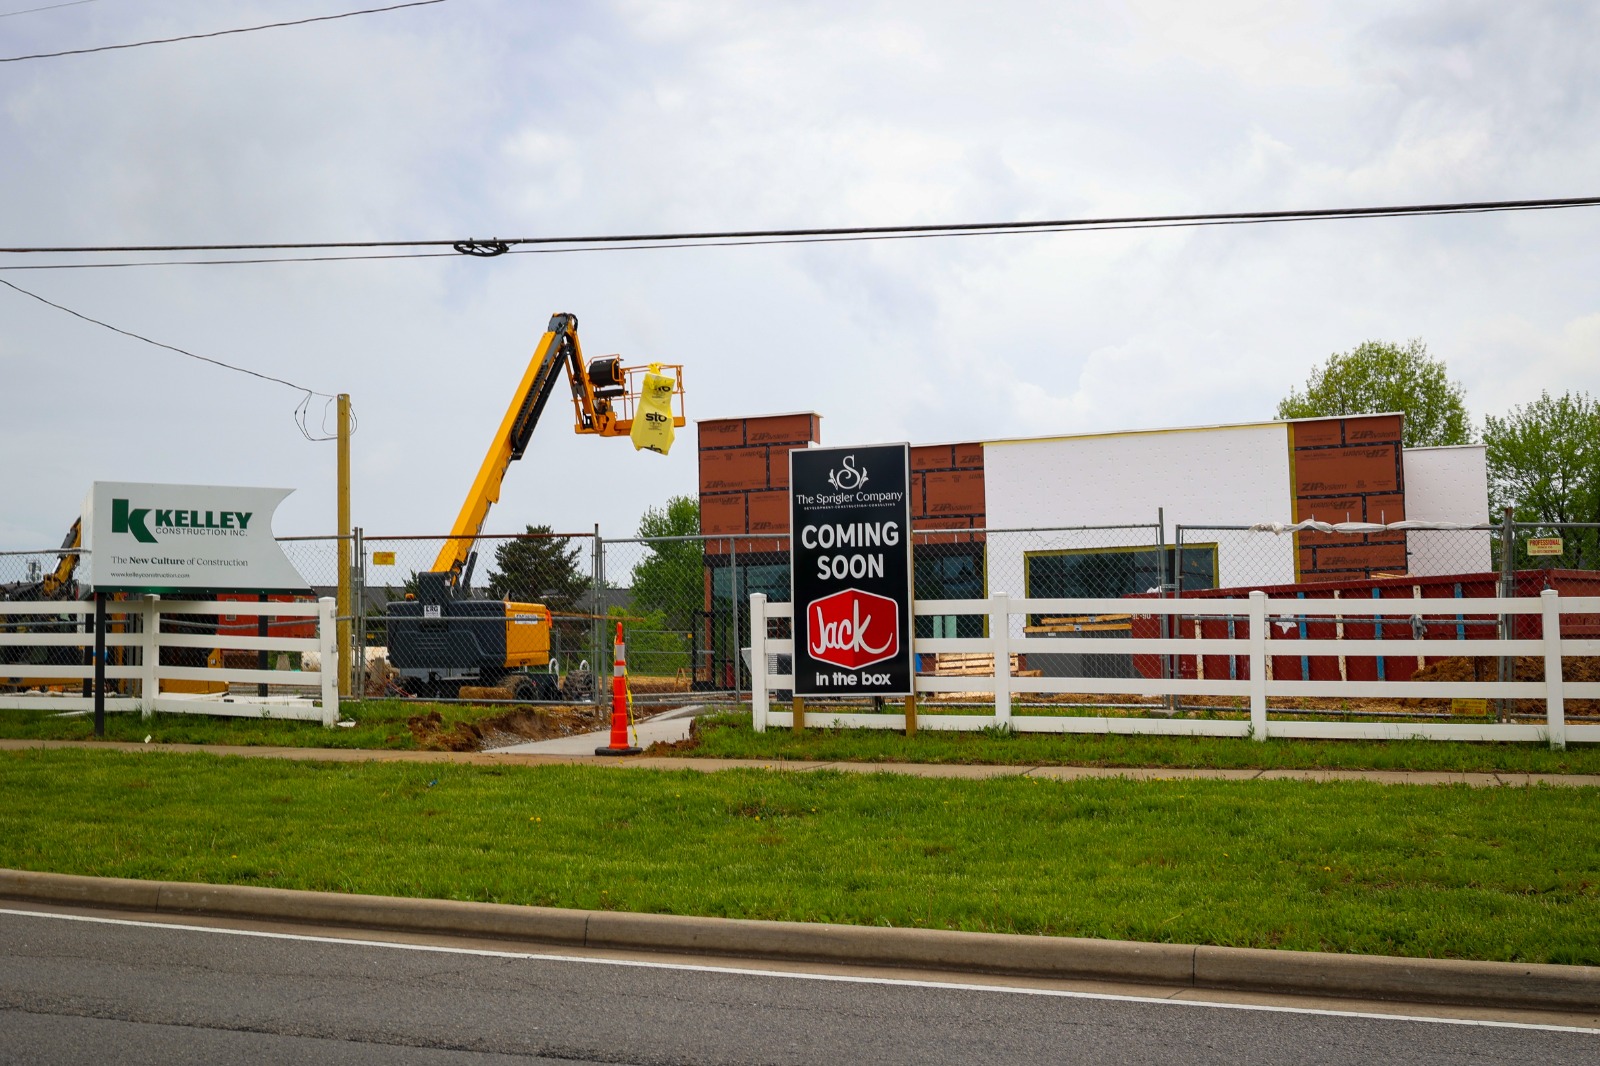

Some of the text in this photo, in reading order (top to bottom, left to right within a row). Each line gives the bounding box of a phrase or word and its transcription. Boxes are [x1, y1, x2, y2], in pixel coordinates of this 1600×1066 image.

[645, 412, 668, 422] sto
[796, 494, 814, 505] The
[816, 493, 854, 505] Sprigler
[856, 491, 903, 503] Company
[155, 509, 252, 529] KELLEY
[155, 527, 227, 536] CONSTRUCTION
[801, 521, 899, 549] COMING
[110, 556, 128, 564] The
[129, 556, 150, 565] New
[150, 556, 186, 565] Culture
[196, 558, 249, 567] Construction
[817, 553, 884, 580] SOON
[812, 599, 893, 655] Jack
[816, 671, 891, 686] in the box
